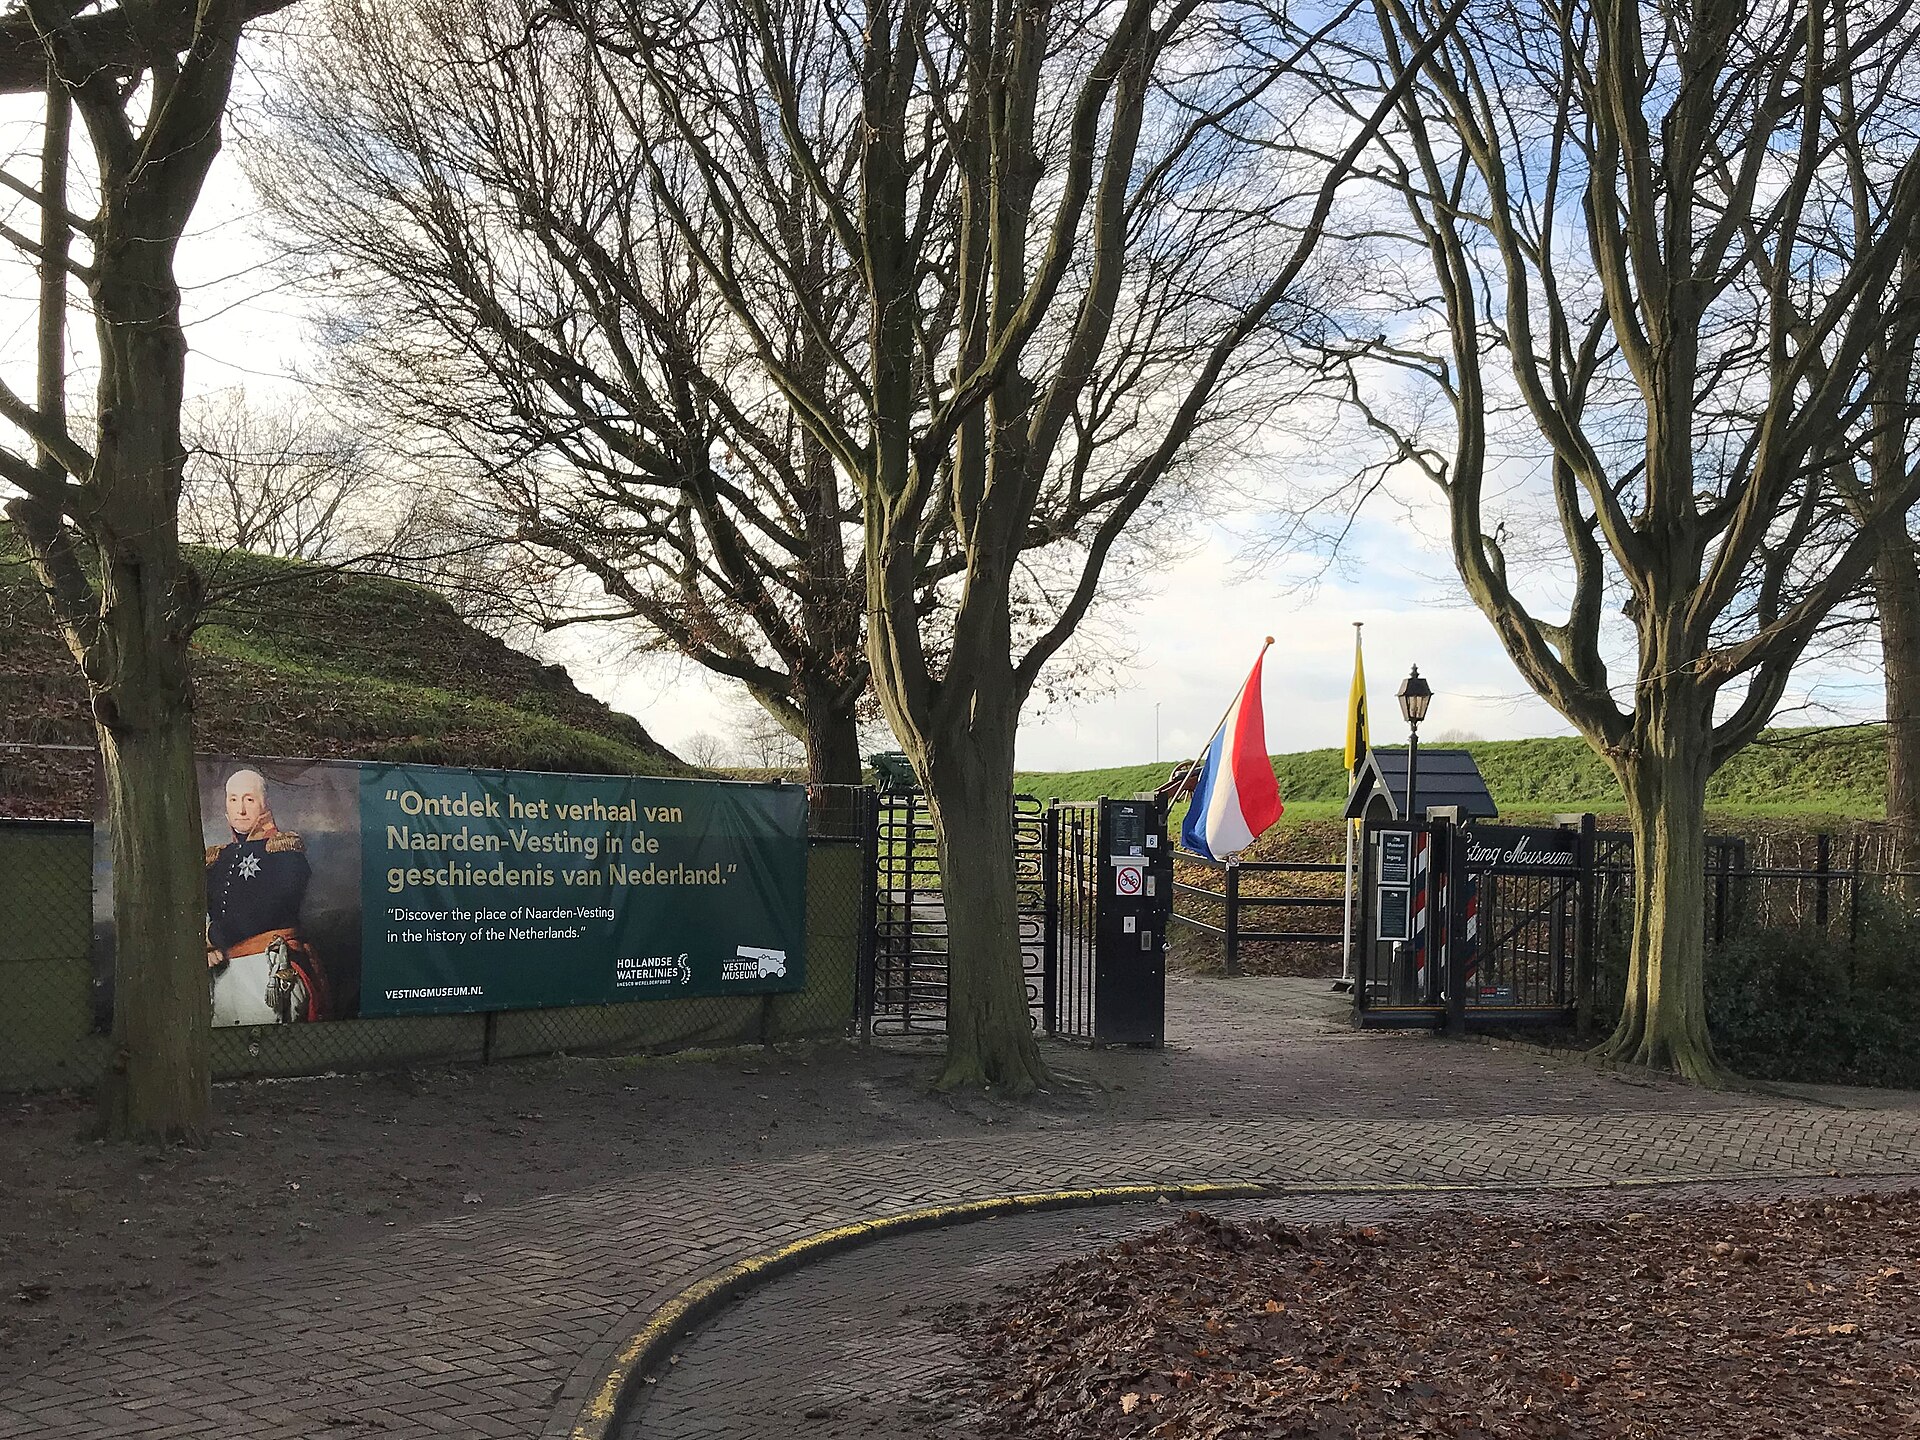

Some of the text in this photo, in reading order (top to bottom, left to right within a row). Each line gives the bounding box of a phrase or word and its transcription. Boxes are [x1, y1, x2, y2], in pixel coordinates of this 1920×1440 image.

[385, 790, 683, 823] “Ontdek het verhaal van
[387, 825, 659, 860] Naarden-Vesting in de
[1503, 835, 1574, 865] Museum
[386, 860, 737, 893] geschiedenis van Nederland.”
[387, 906, 615, 923] “Discover the place of Naarden-Vesting
[387, 926, 587, 944] in the history of the Netherlands.”
[616, 956, 673, 969] HOLLANDSE
[723, 961, 758, 972] VESTING
[616, 967, 679, 980] WATERLINIES
[721, 970, 758, 981] MUSEUM
[385, 986, 484, 1000] VESTINGMUSEUM.NL
